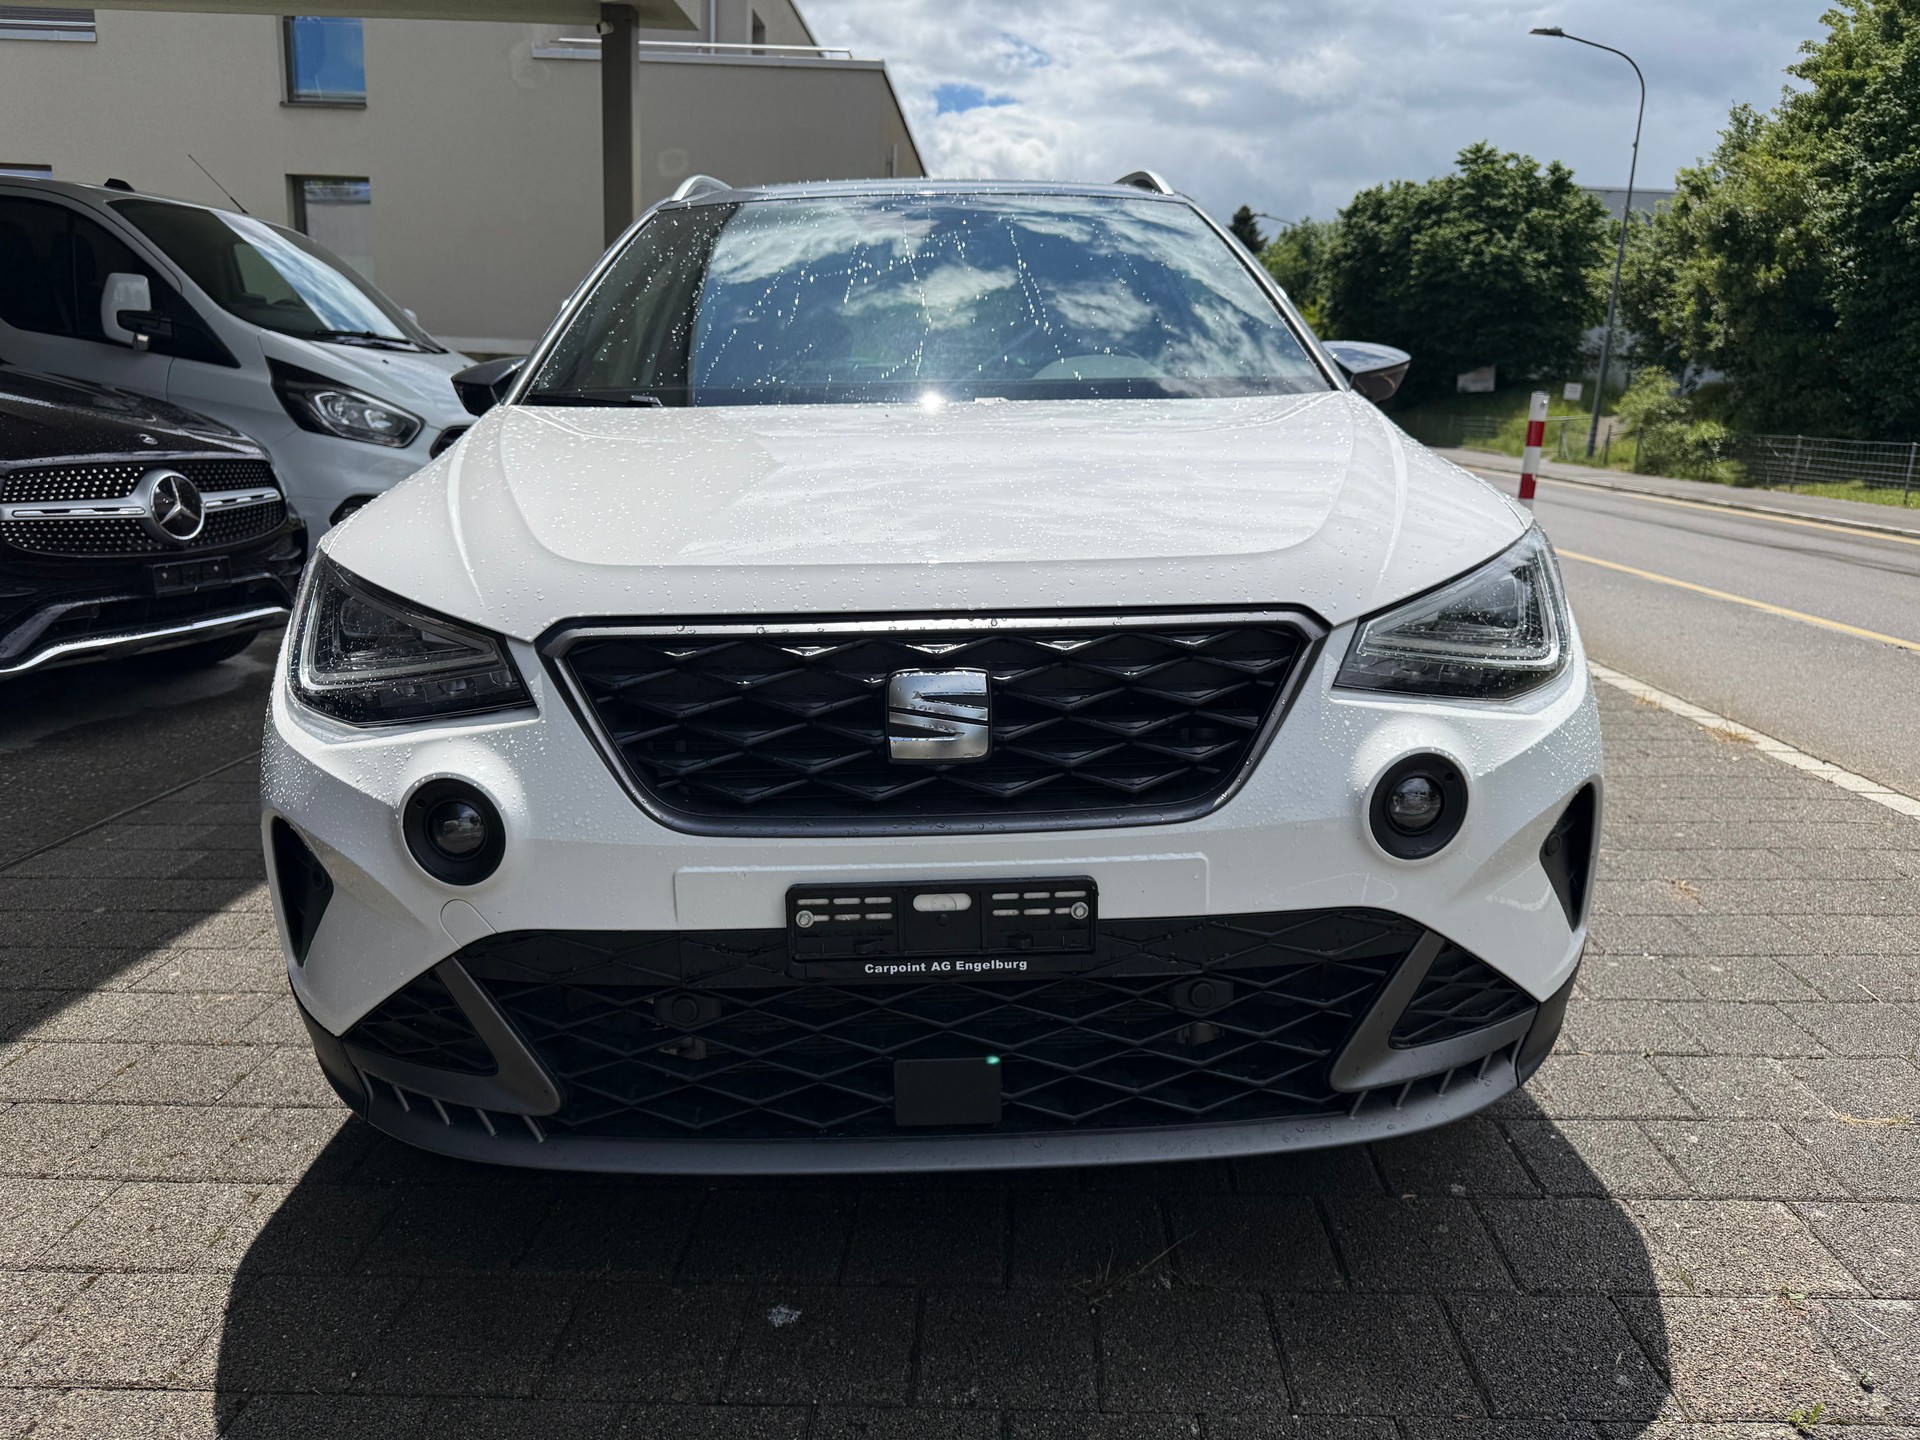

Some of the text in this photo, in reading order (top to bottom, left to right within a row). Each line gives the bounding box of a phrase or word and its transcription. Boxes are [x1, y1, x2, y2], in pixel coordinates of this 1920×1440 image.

[864, 959, 1028, 975] Carpoint AG Engelburg
